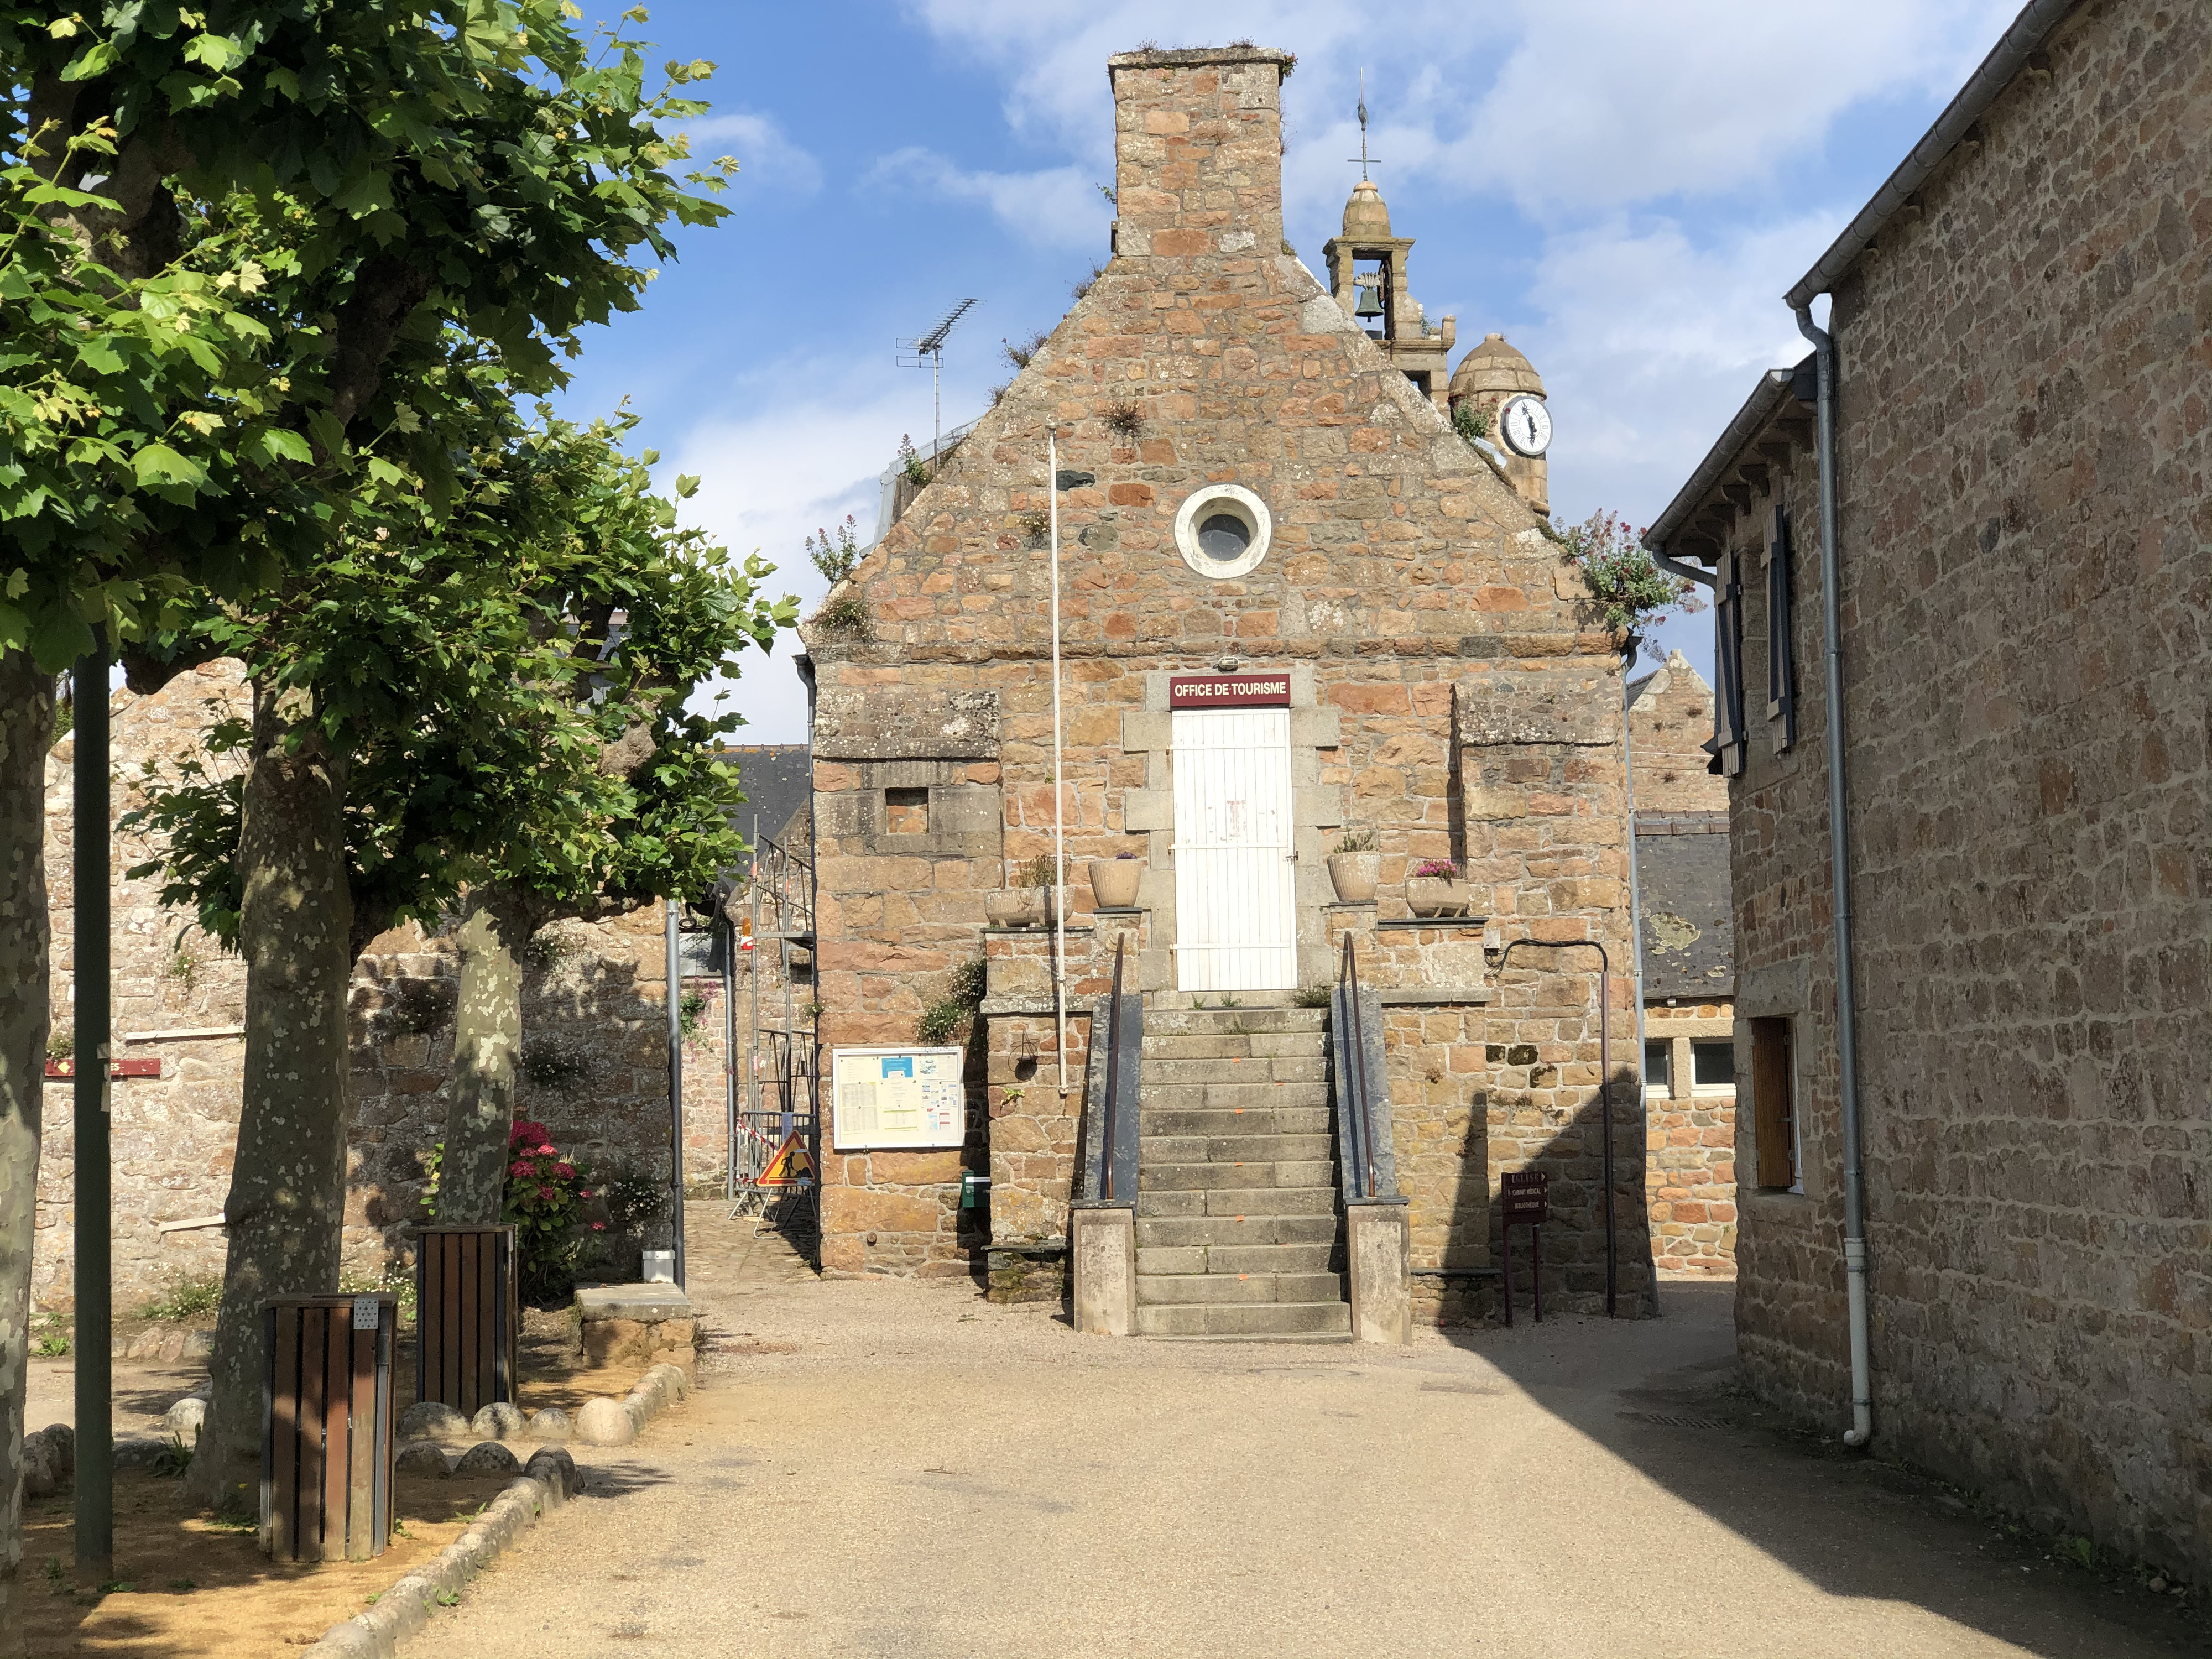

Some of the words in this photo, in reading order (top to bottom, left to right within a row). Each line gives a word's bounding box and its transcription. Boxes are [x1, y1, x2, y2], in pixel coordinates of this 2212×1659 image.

[1175, 684, 1212, 697] OFFICE
[1214, 683, 1229, 696] DE
[1231, 681, 1286, 696] TOURISME
